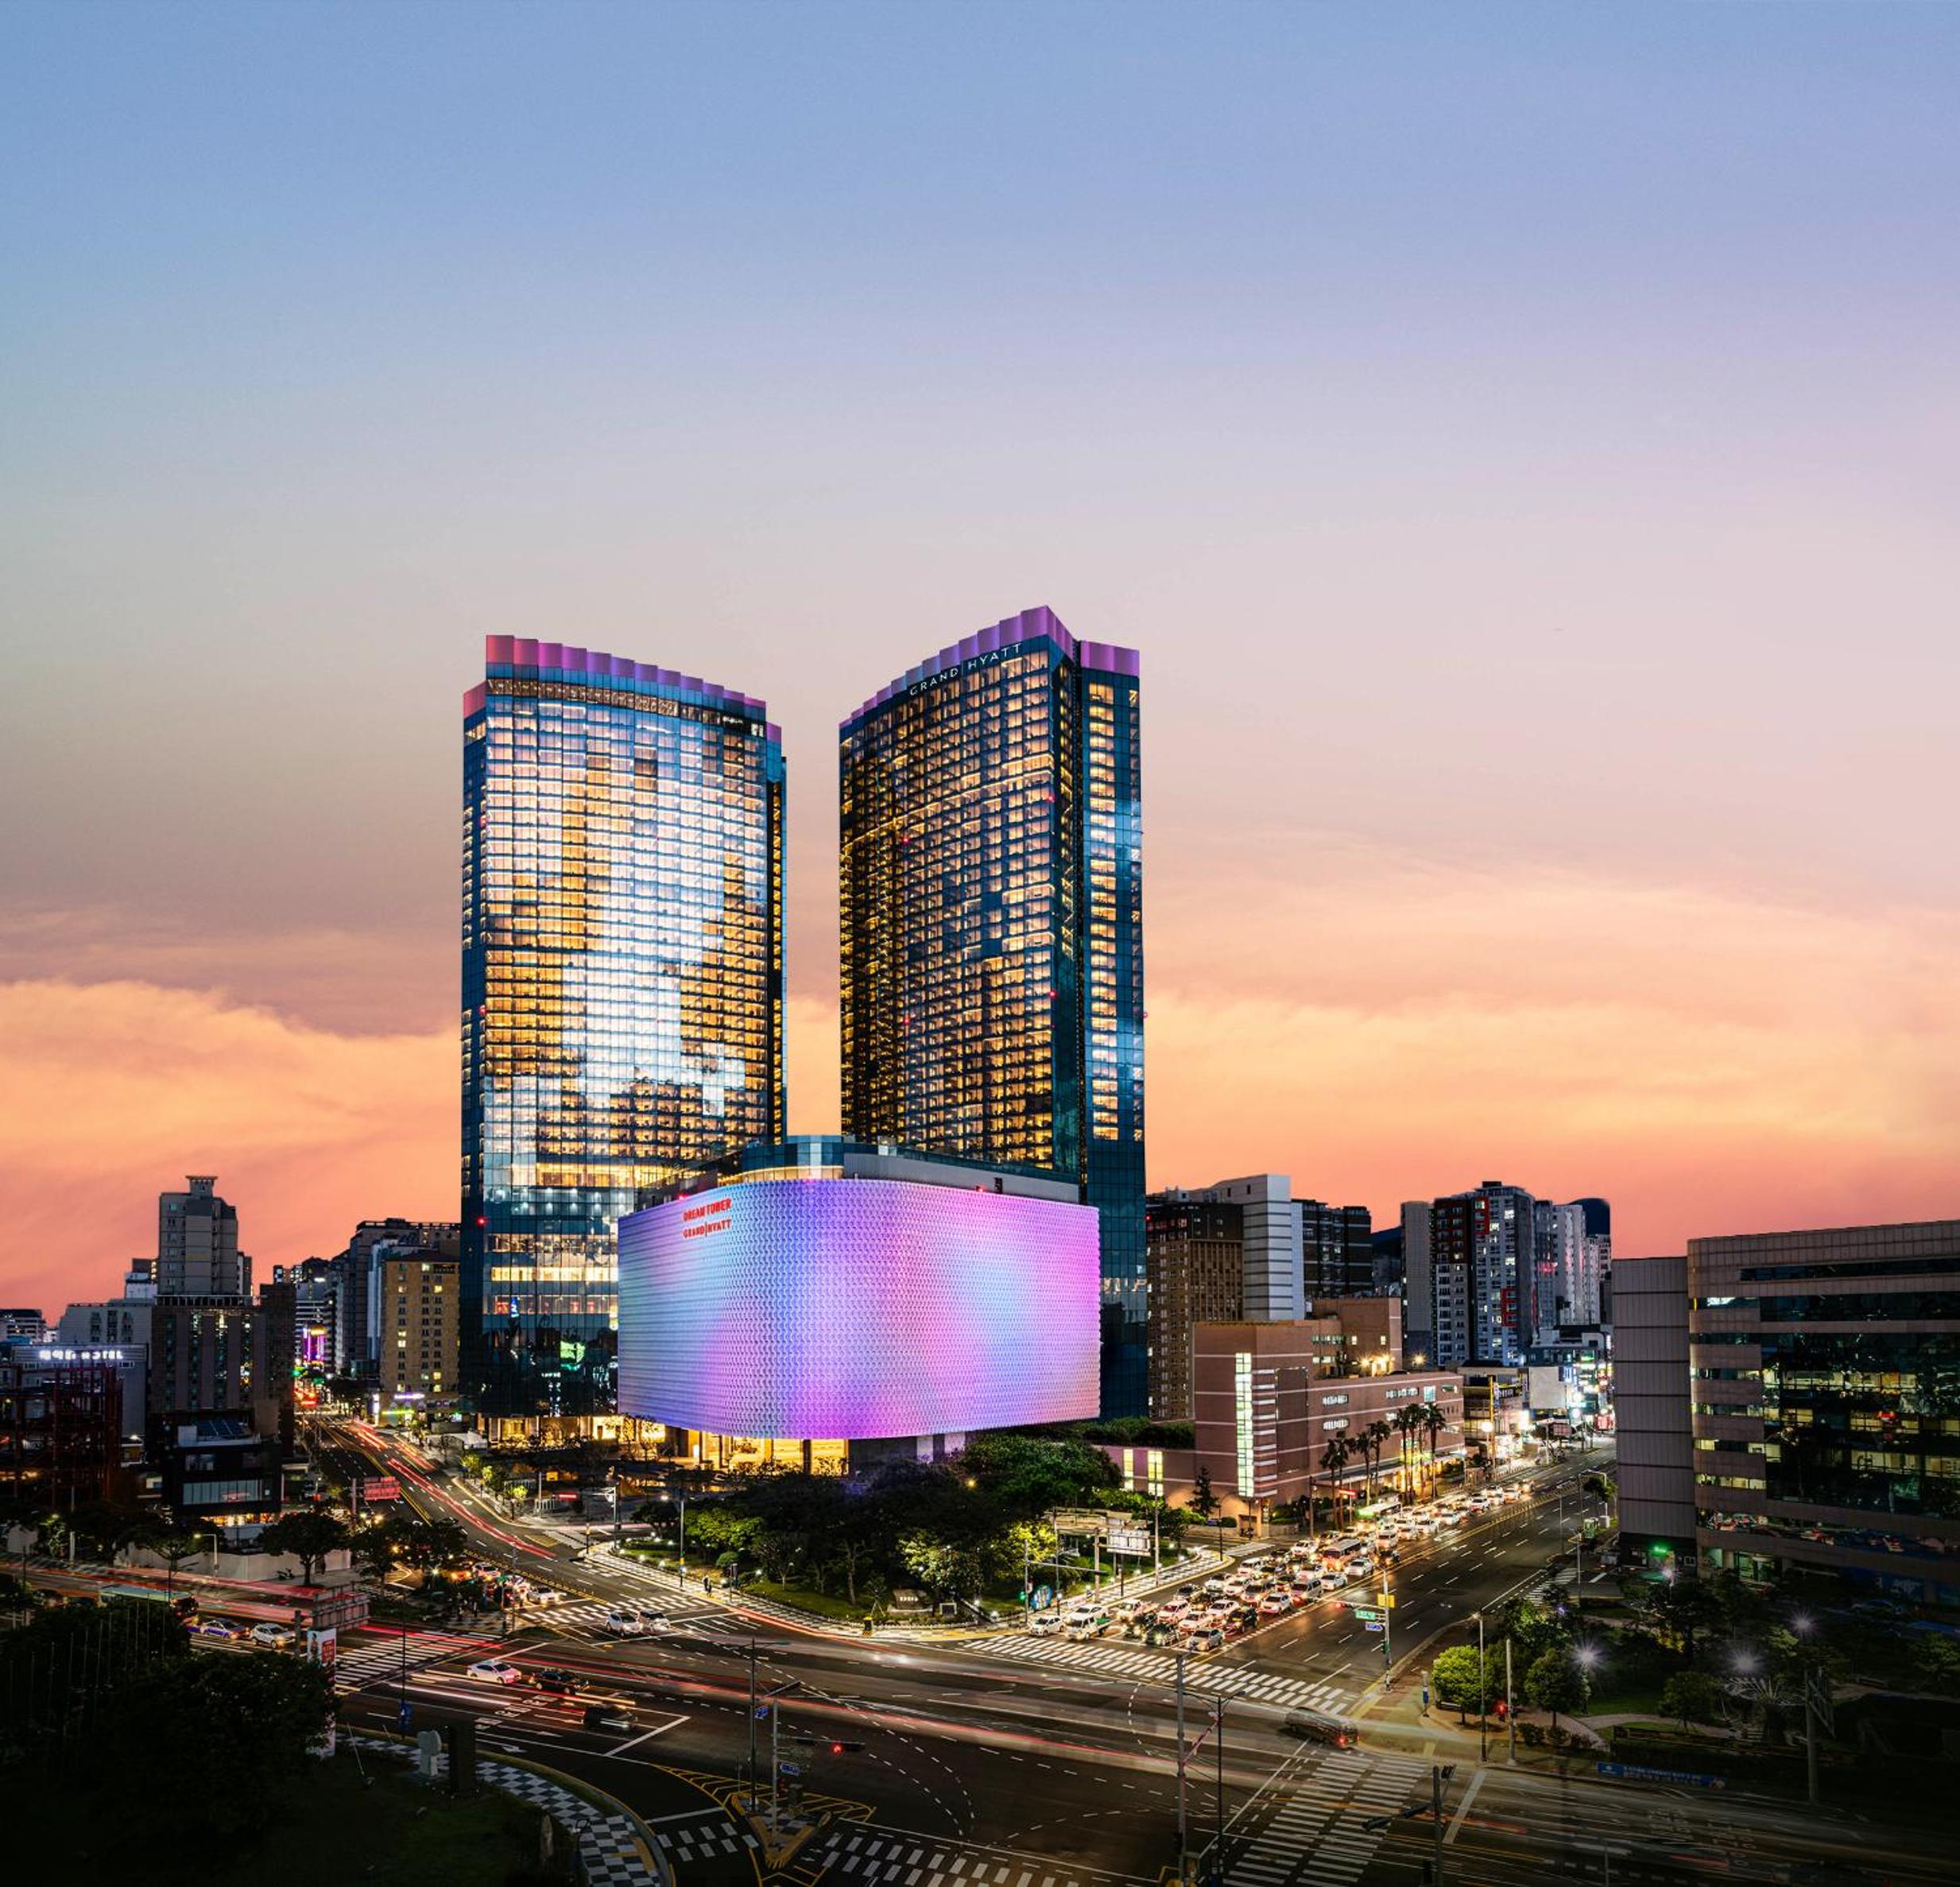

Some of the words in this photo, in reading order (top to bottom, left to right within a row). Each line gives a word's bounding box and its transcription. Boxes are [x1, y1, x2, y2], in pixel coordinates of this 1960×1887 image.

[909, 668, 959, 696] GRAND
[967, 642, 1022, 669] HYATT
[683, 1206, 705, 1222] DREAM
[683, 1225, 705, 1238] GRAND
[707, 1219, 731, 1233] HYATT
